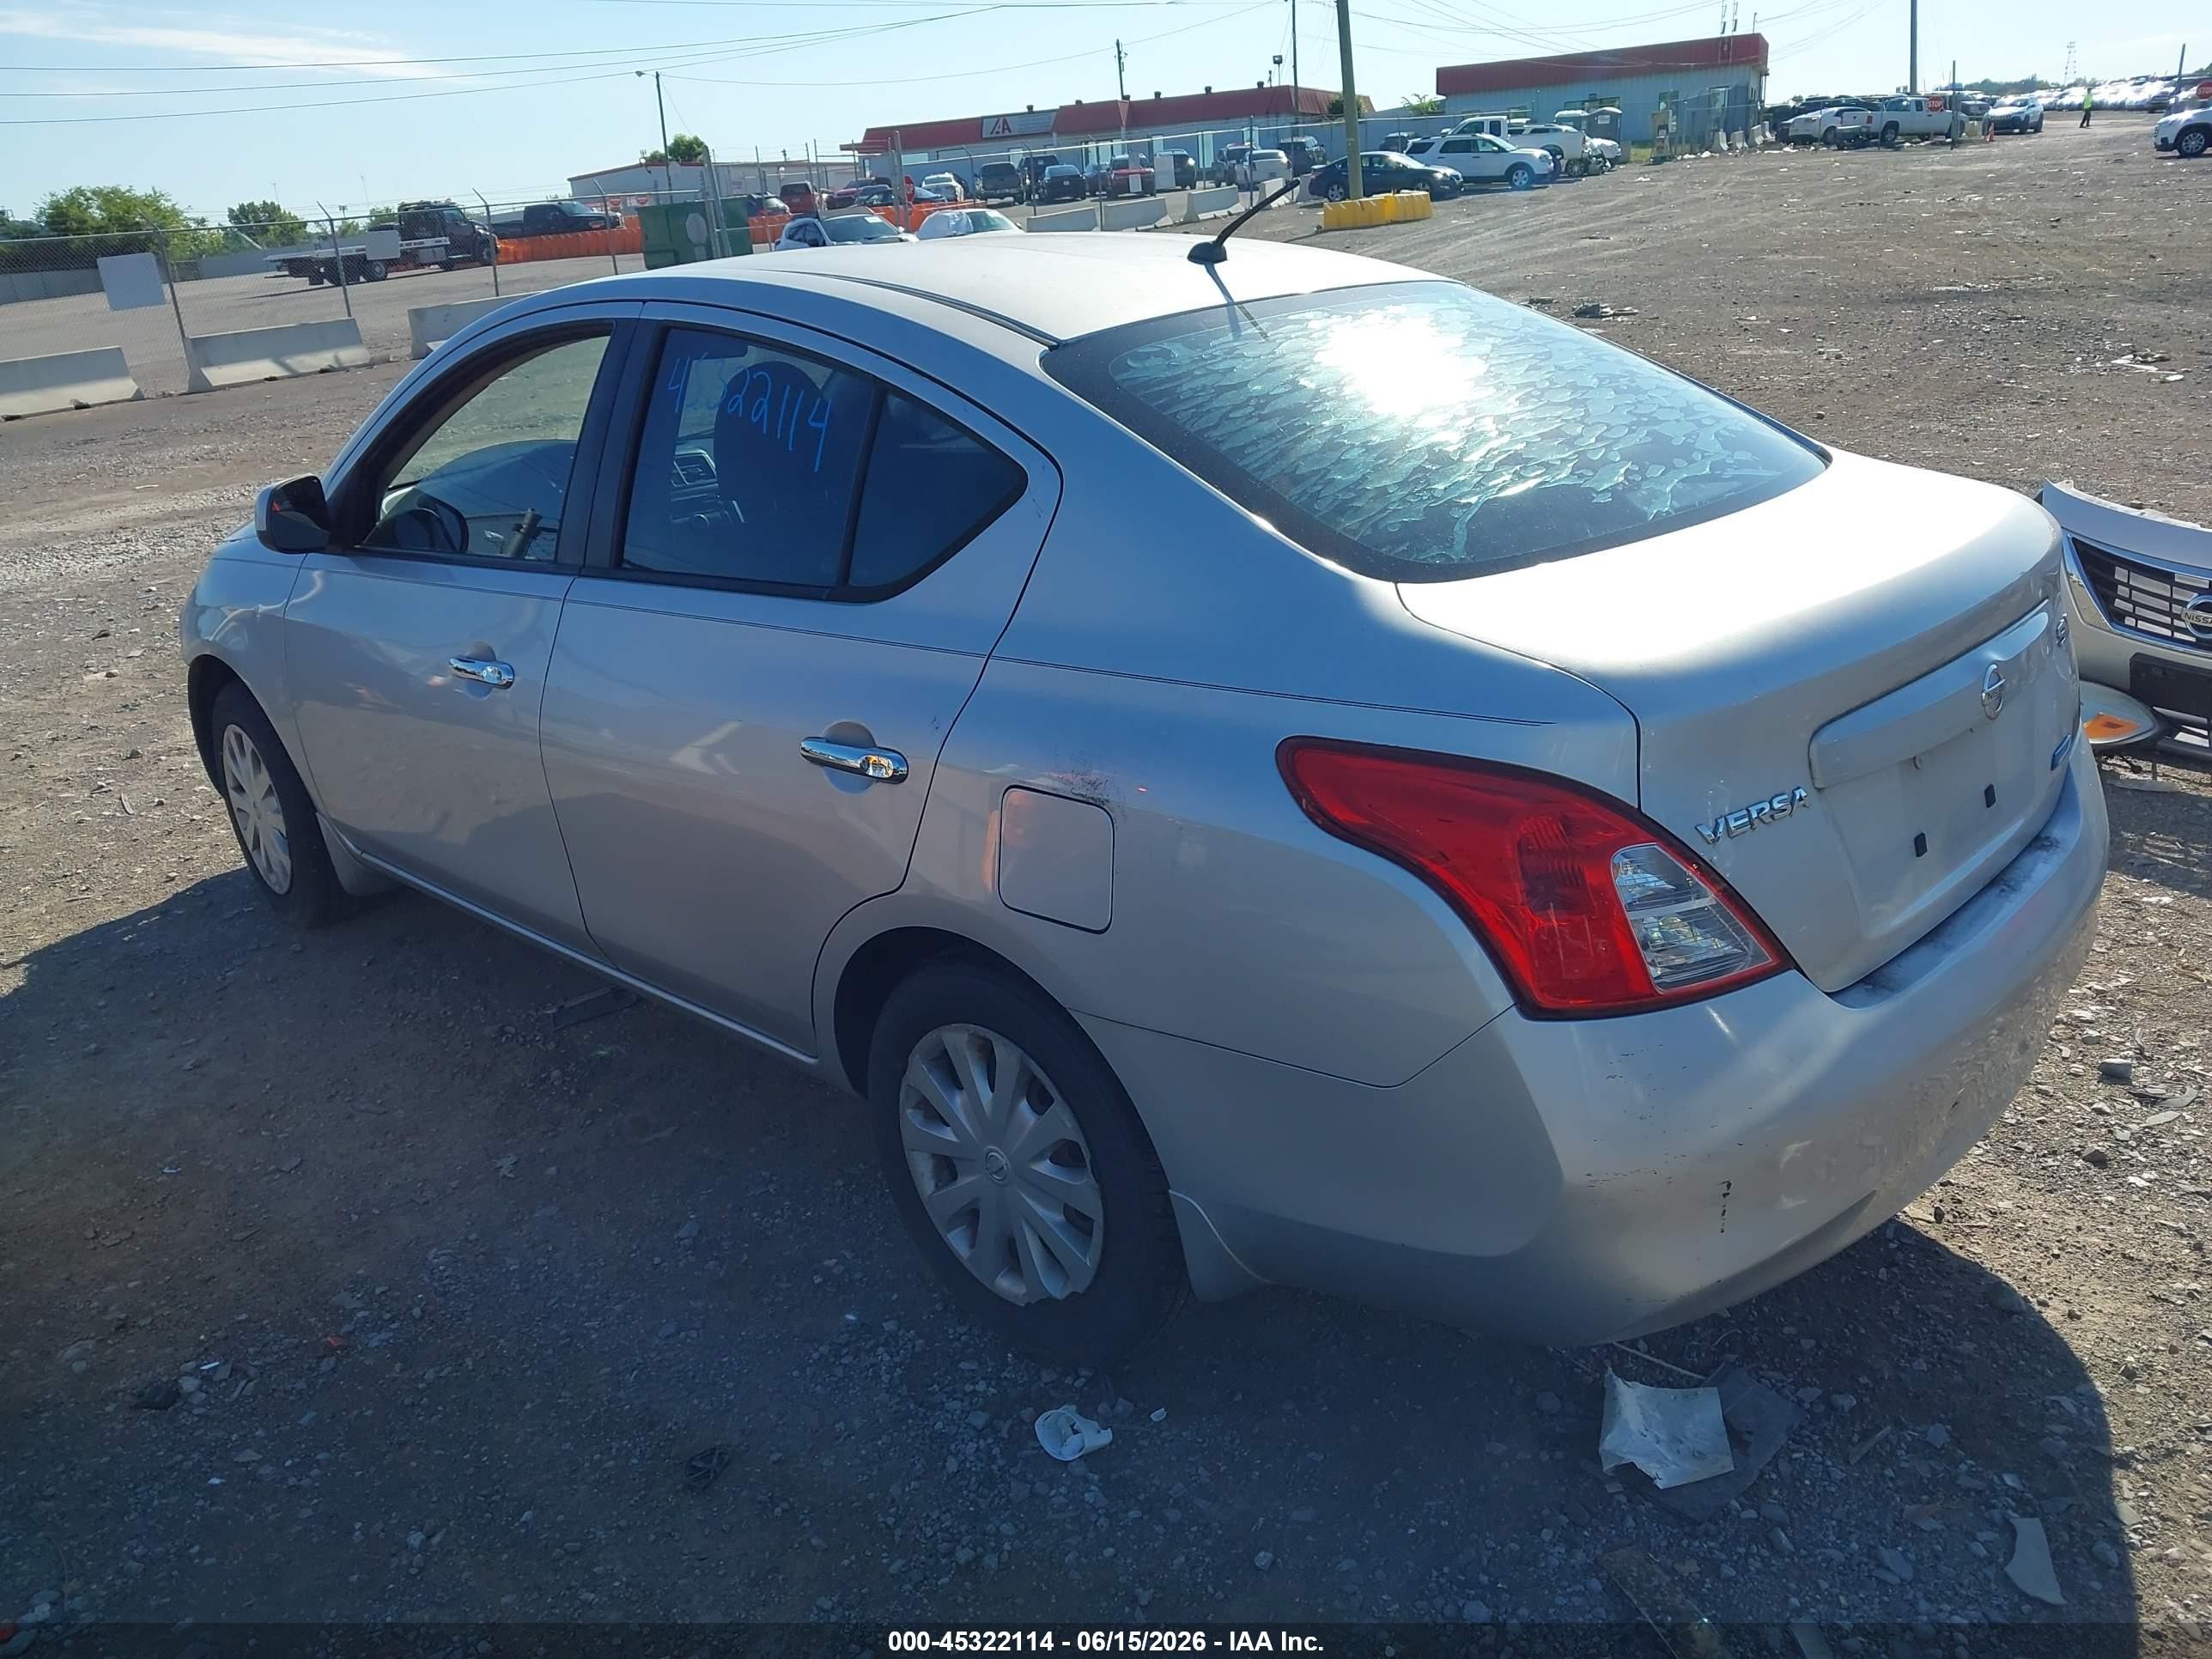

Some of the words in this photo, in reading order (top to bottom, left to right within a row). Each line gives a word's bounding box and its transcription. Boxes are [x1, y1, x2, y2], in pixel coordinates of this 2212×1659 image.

[2197, 87, 2212, 95] STO
[1926, 99, 1942, 108] STOP
[1694, 786, 1810, 844] VERSA
